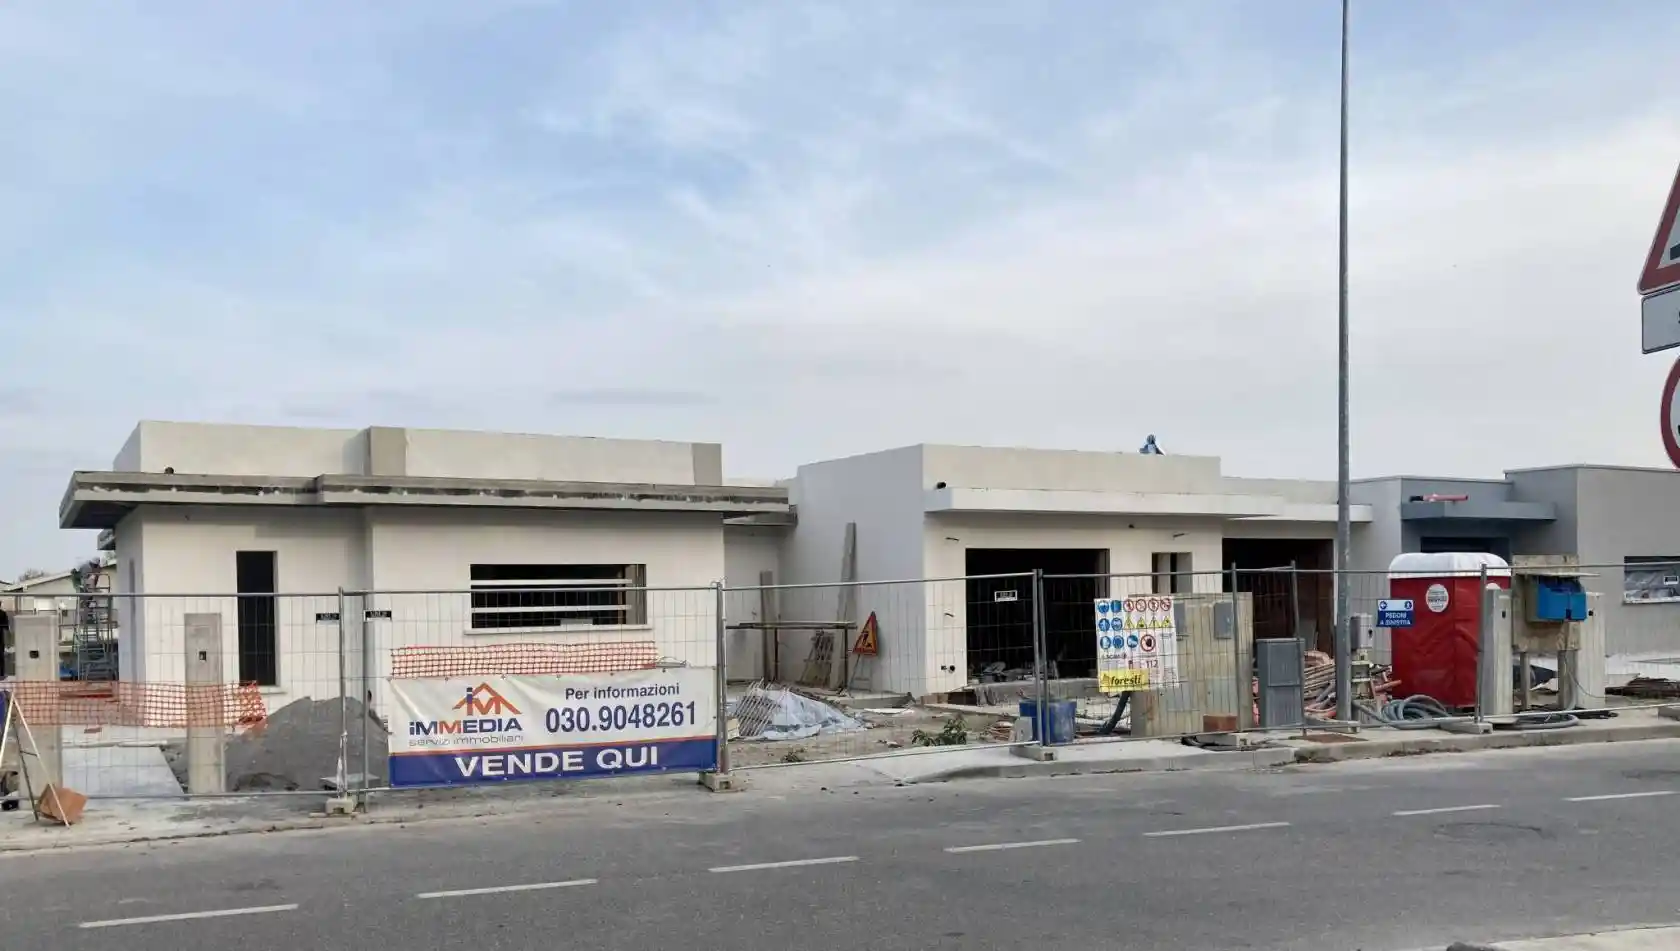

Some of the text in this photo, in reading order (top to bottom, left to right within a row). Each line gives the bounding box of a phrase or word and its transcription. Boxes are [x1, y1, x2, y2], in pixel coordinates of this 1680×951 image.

[1111, 675, 1142, 686] foresti
[565, 682, 680, 701] Per informazioni
[409, 717, 523, 736] iMMEDIA
[545, 700, 697, 734] 030.9048261
[409, 734, 524, 747] servizi immobiliari
[454, 745, 658, 778] VENDE QUI
